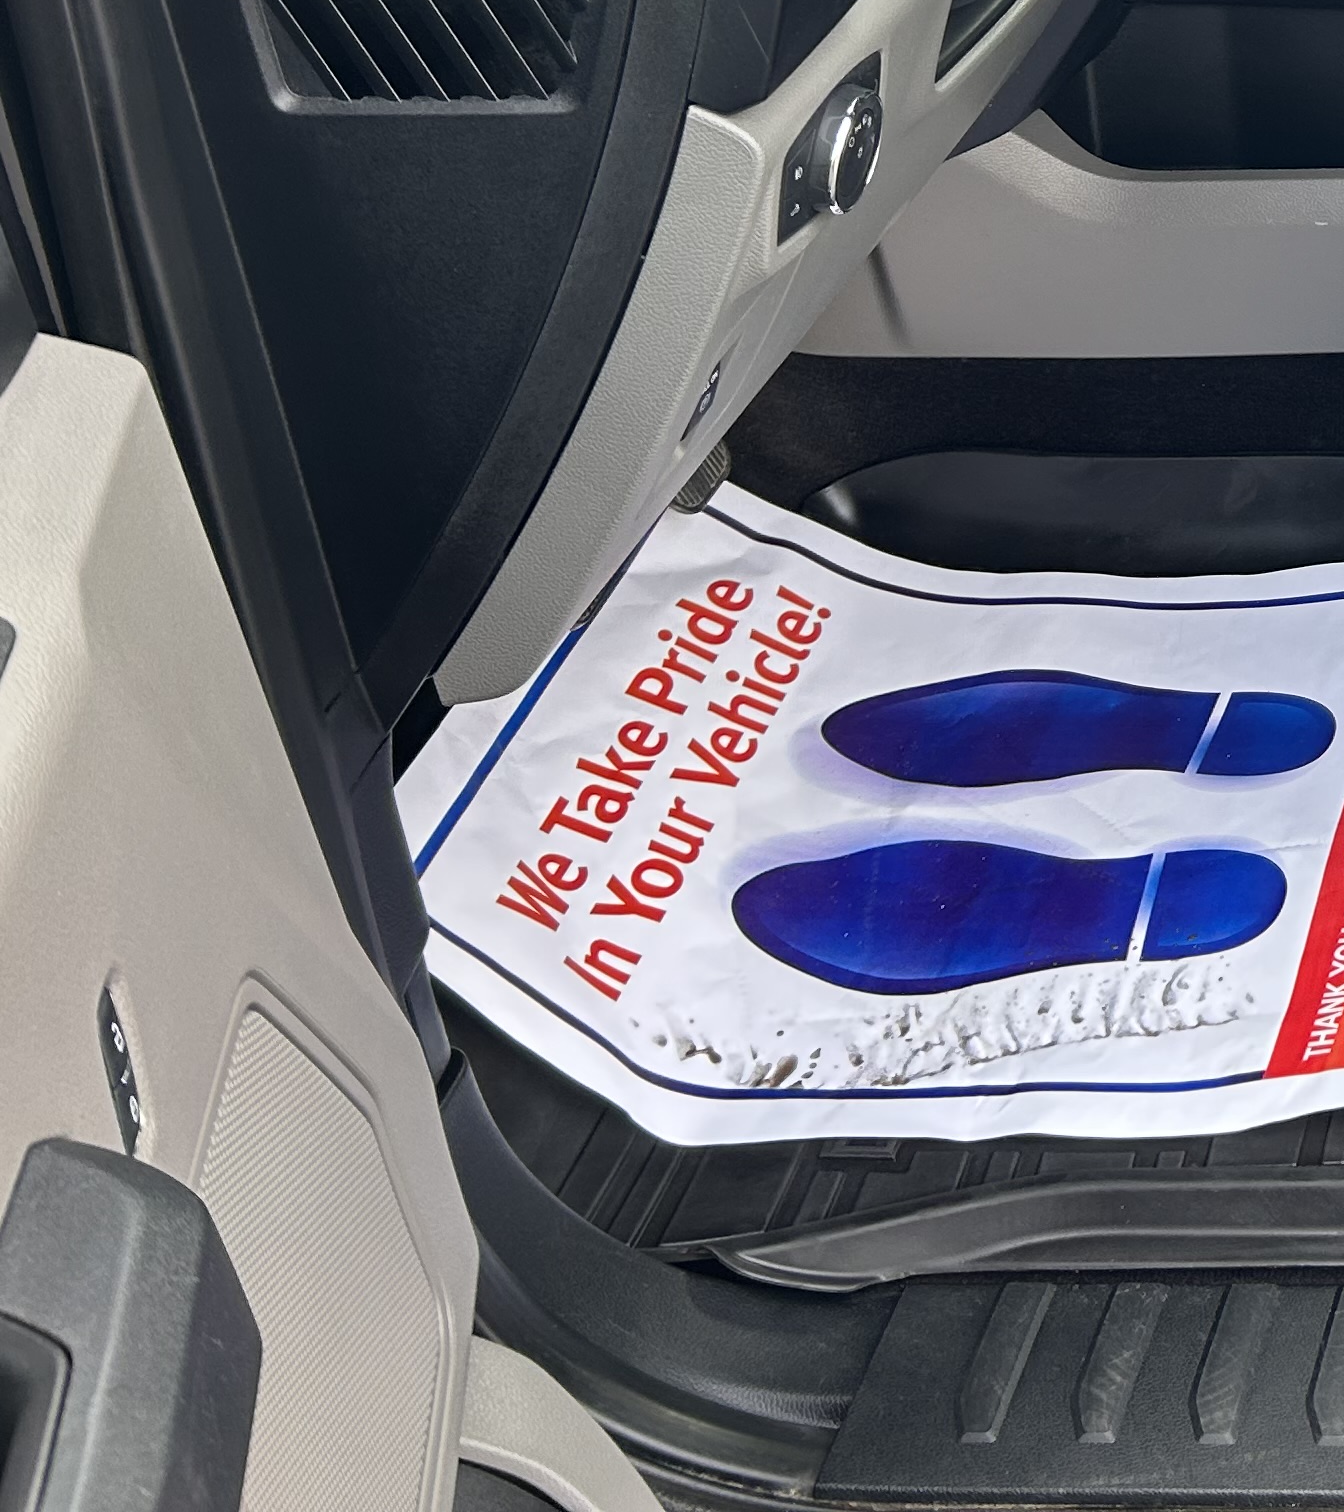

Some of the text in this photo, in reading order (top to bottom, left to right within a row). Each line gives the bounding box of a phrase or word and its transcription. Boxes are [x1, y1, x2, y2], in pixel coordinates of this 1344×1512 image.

[496, 579, 754, 932] We Take Pride
[563, 585, 832, 1002] In Your Vehicle!
